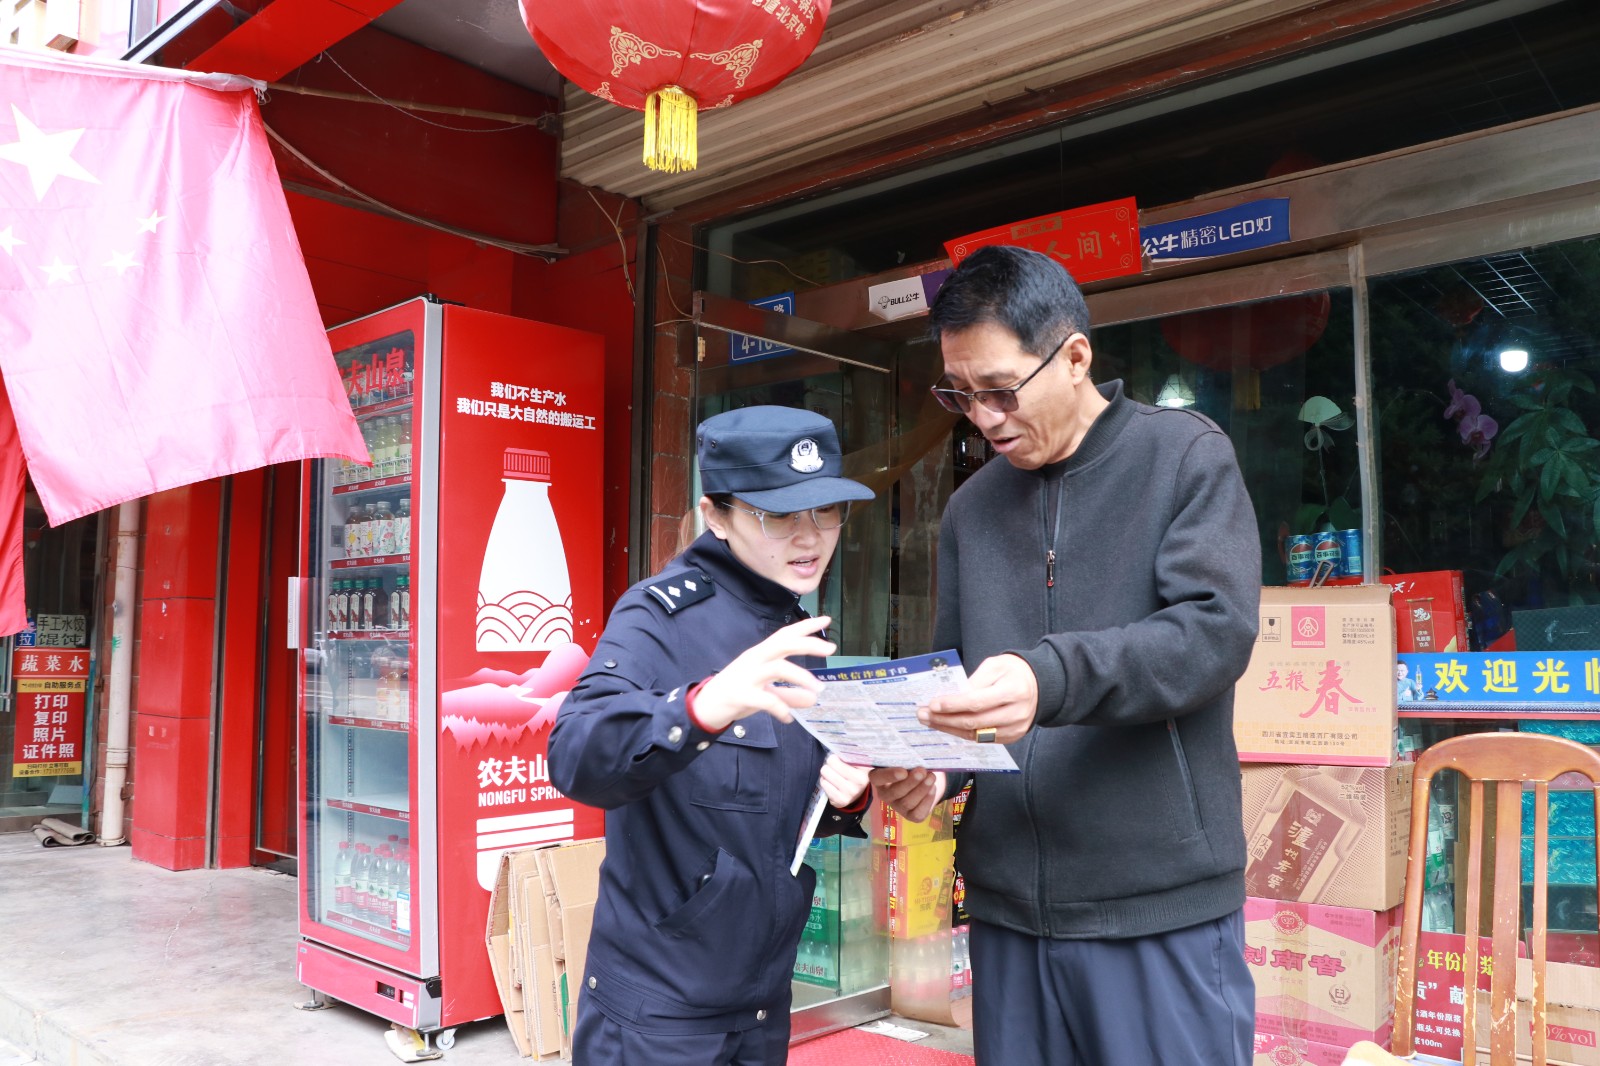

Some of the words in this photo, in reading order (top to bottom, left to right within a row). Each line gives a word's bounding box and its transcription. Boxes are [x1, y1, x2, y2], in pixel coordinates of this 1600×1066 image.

[792, 0, 816, 24] 锅头
[1027, 230, 1103, 260] 人间
[1141, 216, 1272, 258] 公牛精密LED灯
[340, 347, 406, 398] 夫山泉
[490, 381, 567, 407] 我们不生产水
[456, 397, 597, 430] 我们只是大自然的搬运工
[38, 615, 85, 631] 手工水饺
[38, 632, 83, 647] 馄饨
[21, 654, 84, 673] 蔬菜水
[1258, 659, 1365, 719] 五粮春
[34, 694, 69, 710] 打印
[33, 711, 68, 726] 复印
[32, 727, 66, 742] 照片
[22, 743, 75, 760] 证件照
[477, 753, 550, 789] 农夫山
[478, 788, 527, 808] NONGFU
[1427, 949, 1493, 976] 年份浆
